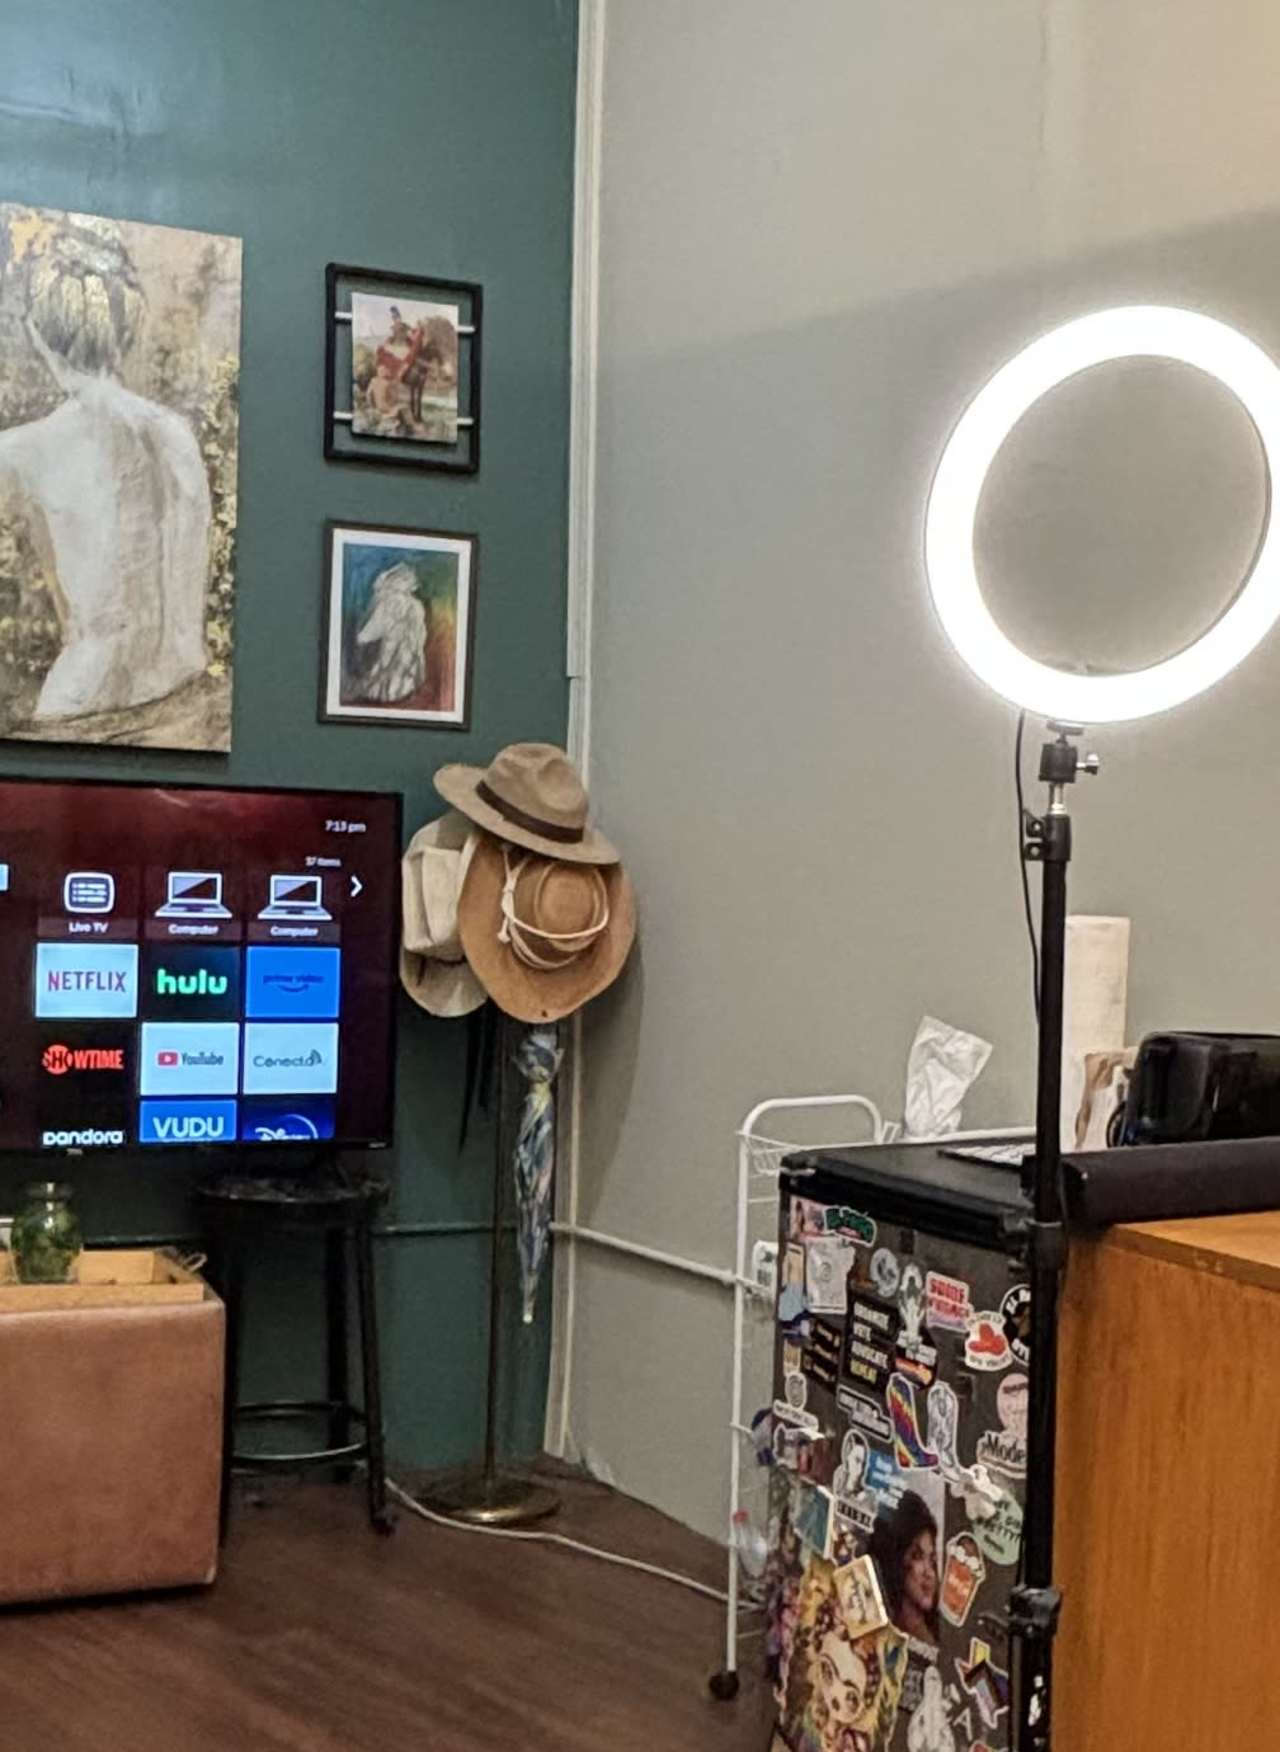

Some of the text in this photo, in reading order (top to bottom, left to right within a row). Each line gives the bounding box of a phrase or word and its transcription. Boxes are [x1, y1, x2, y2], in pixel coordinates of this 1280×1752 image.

[69, 922, 109, 933] Live TV
[168, 923, 219, 935] Computer
[270, 926, 319, 938] Computer
[48, 971, 127, 992] NETFLIX
[157, 968, 228, 995] hulu
[43, 1045, 124, 1074] SHOWTIME
[182, 1051, 224, 1067] YouTube
[152, 1116, 225, 1138] VUDU
[42, 1129, 123, 1146] pandora
